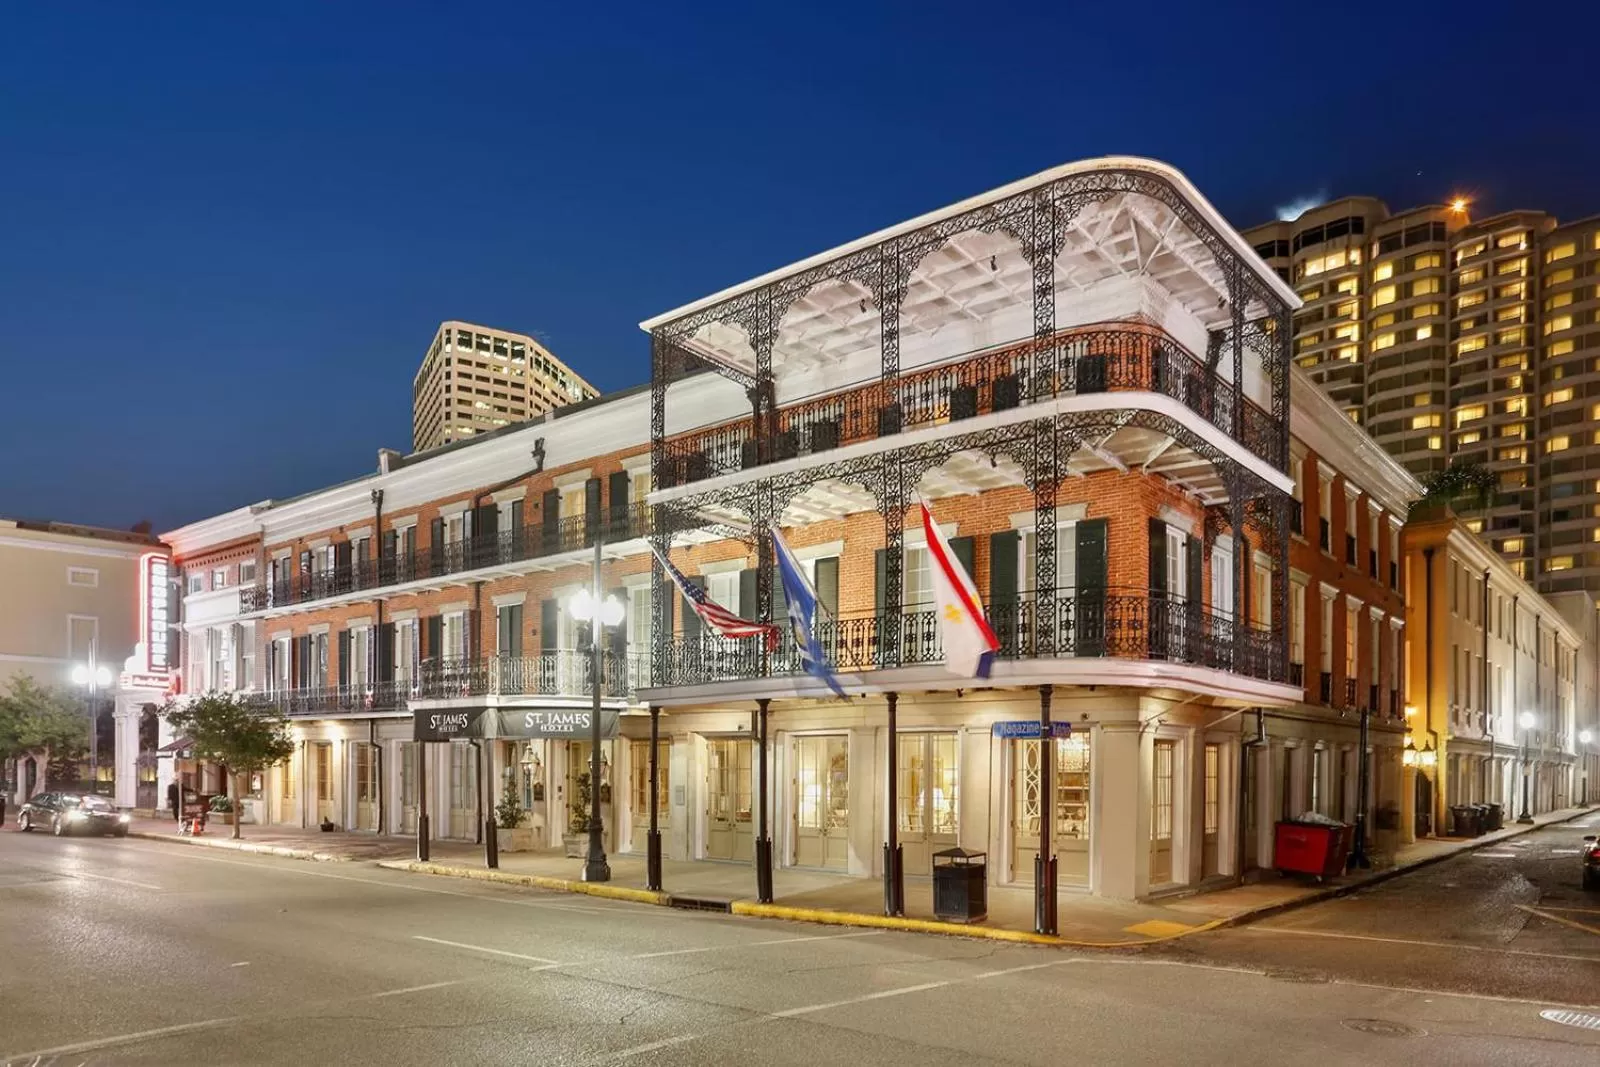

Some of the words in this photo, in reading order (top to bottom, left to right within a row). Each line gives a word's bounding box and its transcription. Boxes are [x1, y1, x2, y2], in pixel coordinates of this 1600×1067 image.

[443, 713, 468, 728] JAMES
[525, 712, 543, 728] ST.
[547, 712, 590, 728] JAMES
[541, 724, 574, 732] HOTEL
